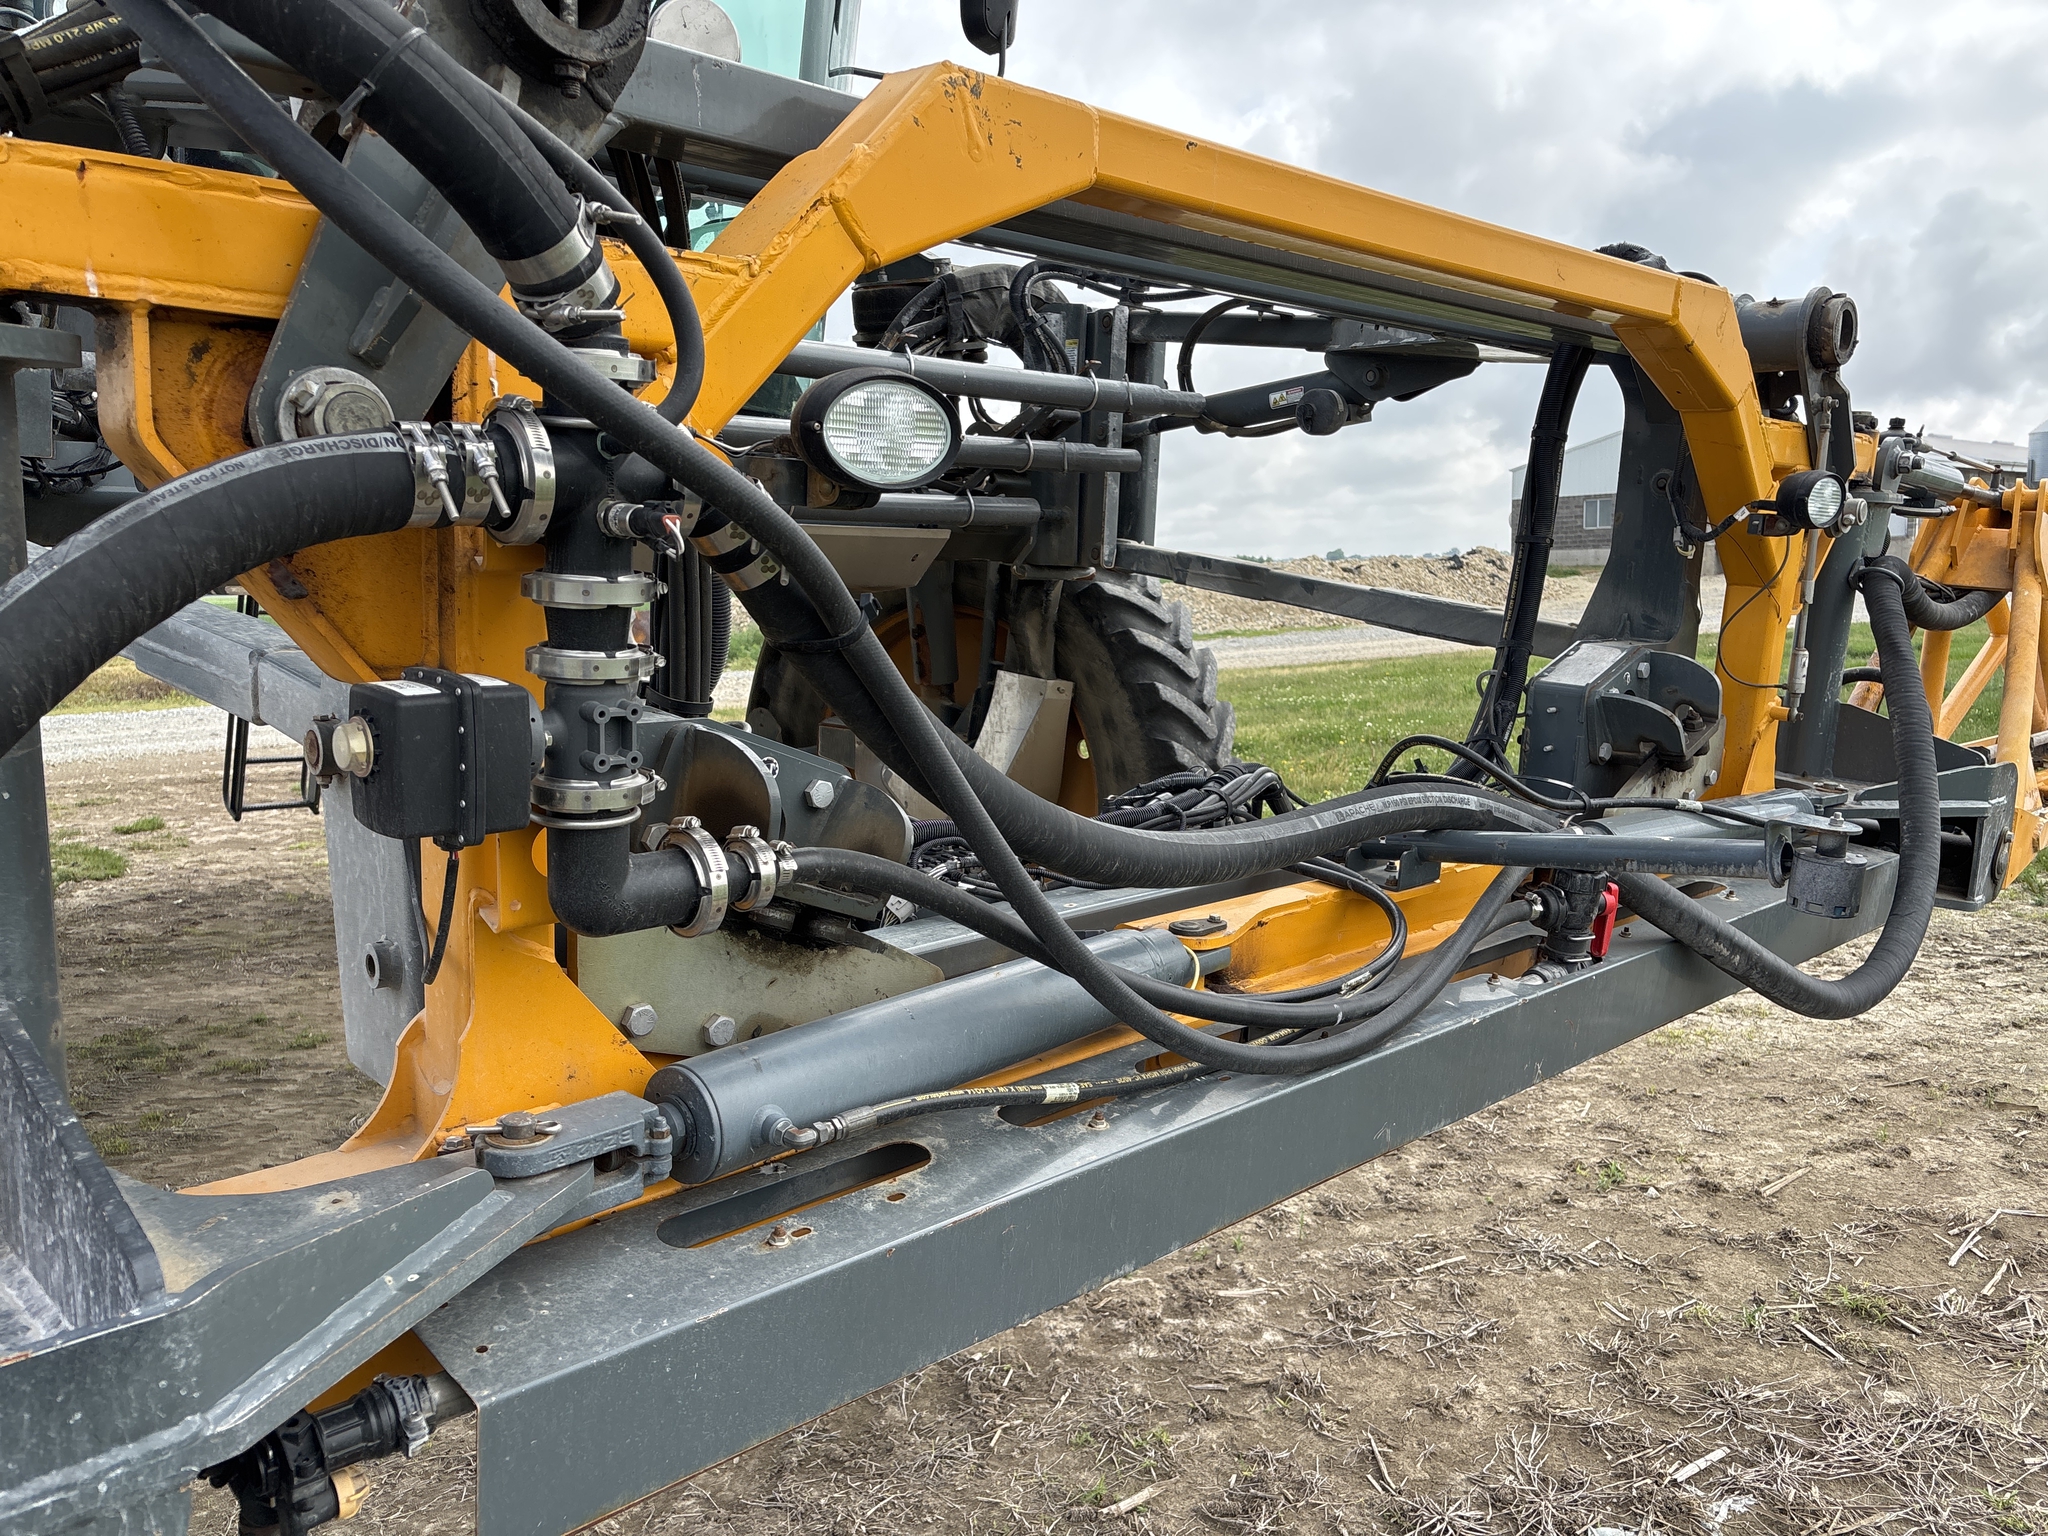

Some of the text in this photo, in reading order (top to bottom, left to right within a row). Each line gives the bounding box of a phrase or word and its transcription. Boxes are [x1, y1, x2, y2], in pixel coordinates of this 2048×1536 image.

[54, 27, 82, 44] 21.0
[85, 21, 108, 34] WP
[99, 461, 245, 531] NOT FOR STEAM SERVICE
[1344, 803, 1375, 818] APACHE
[1421, 795, 1442, 804] SUCTION
[1443, 795, 1471, 807] DISCHARGE
[1142, 1070, 1160, 1080] MSHA
[575, 1128, 634, 1158] BZ42
